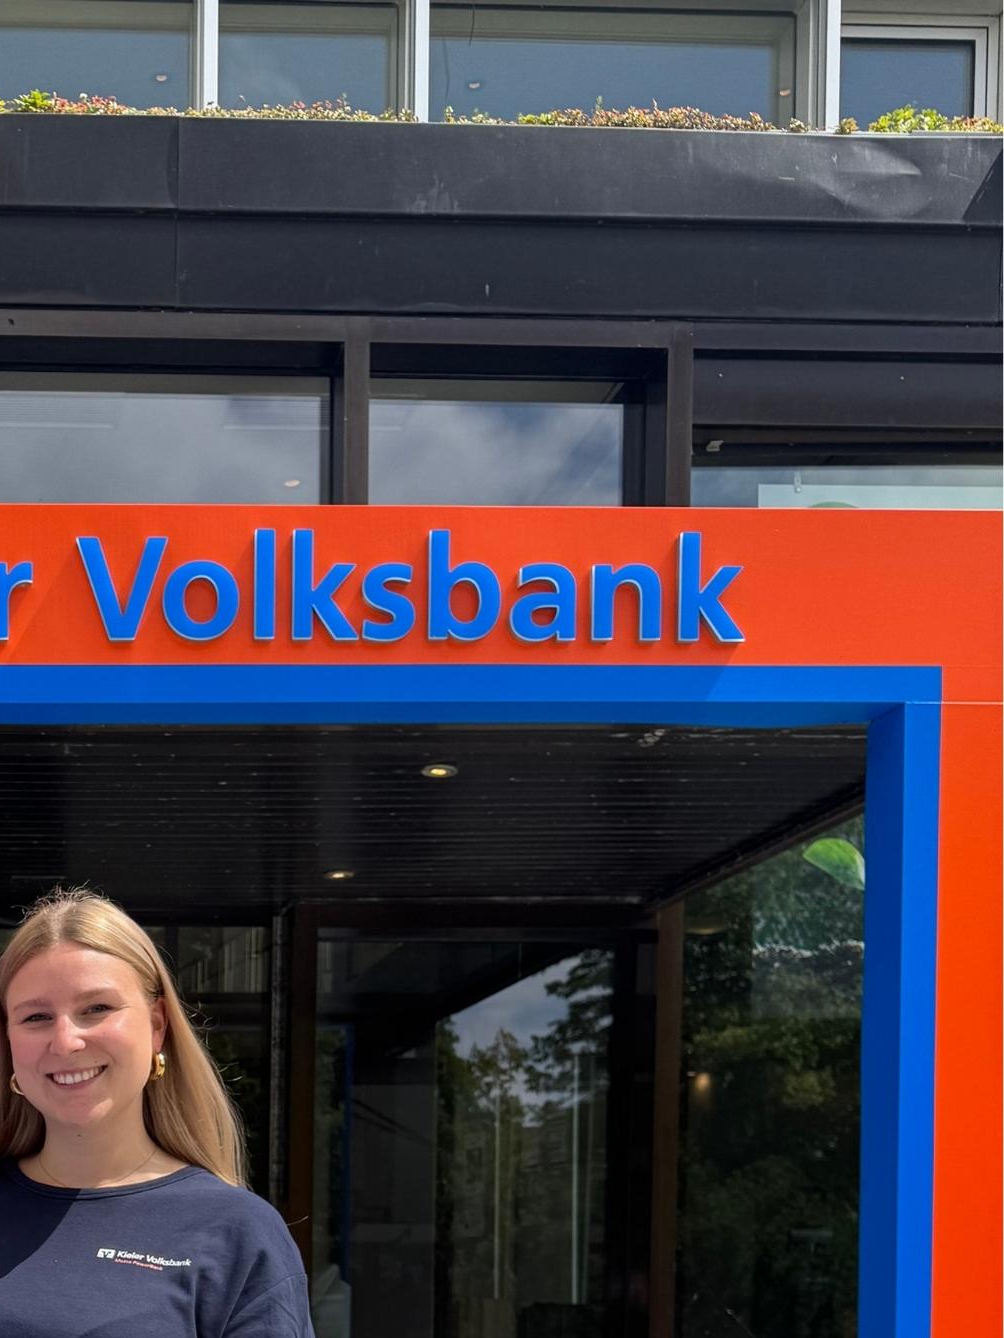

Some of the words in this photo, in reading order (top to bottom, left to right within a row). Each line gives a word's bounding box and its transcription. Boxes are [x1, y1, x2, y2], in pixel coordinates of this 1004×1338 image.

[75, 527, 746, 643] Volksbank
[117, 1250, 145, 1260] Kieler
[146, 1254, 192, 1267] Volksbank
